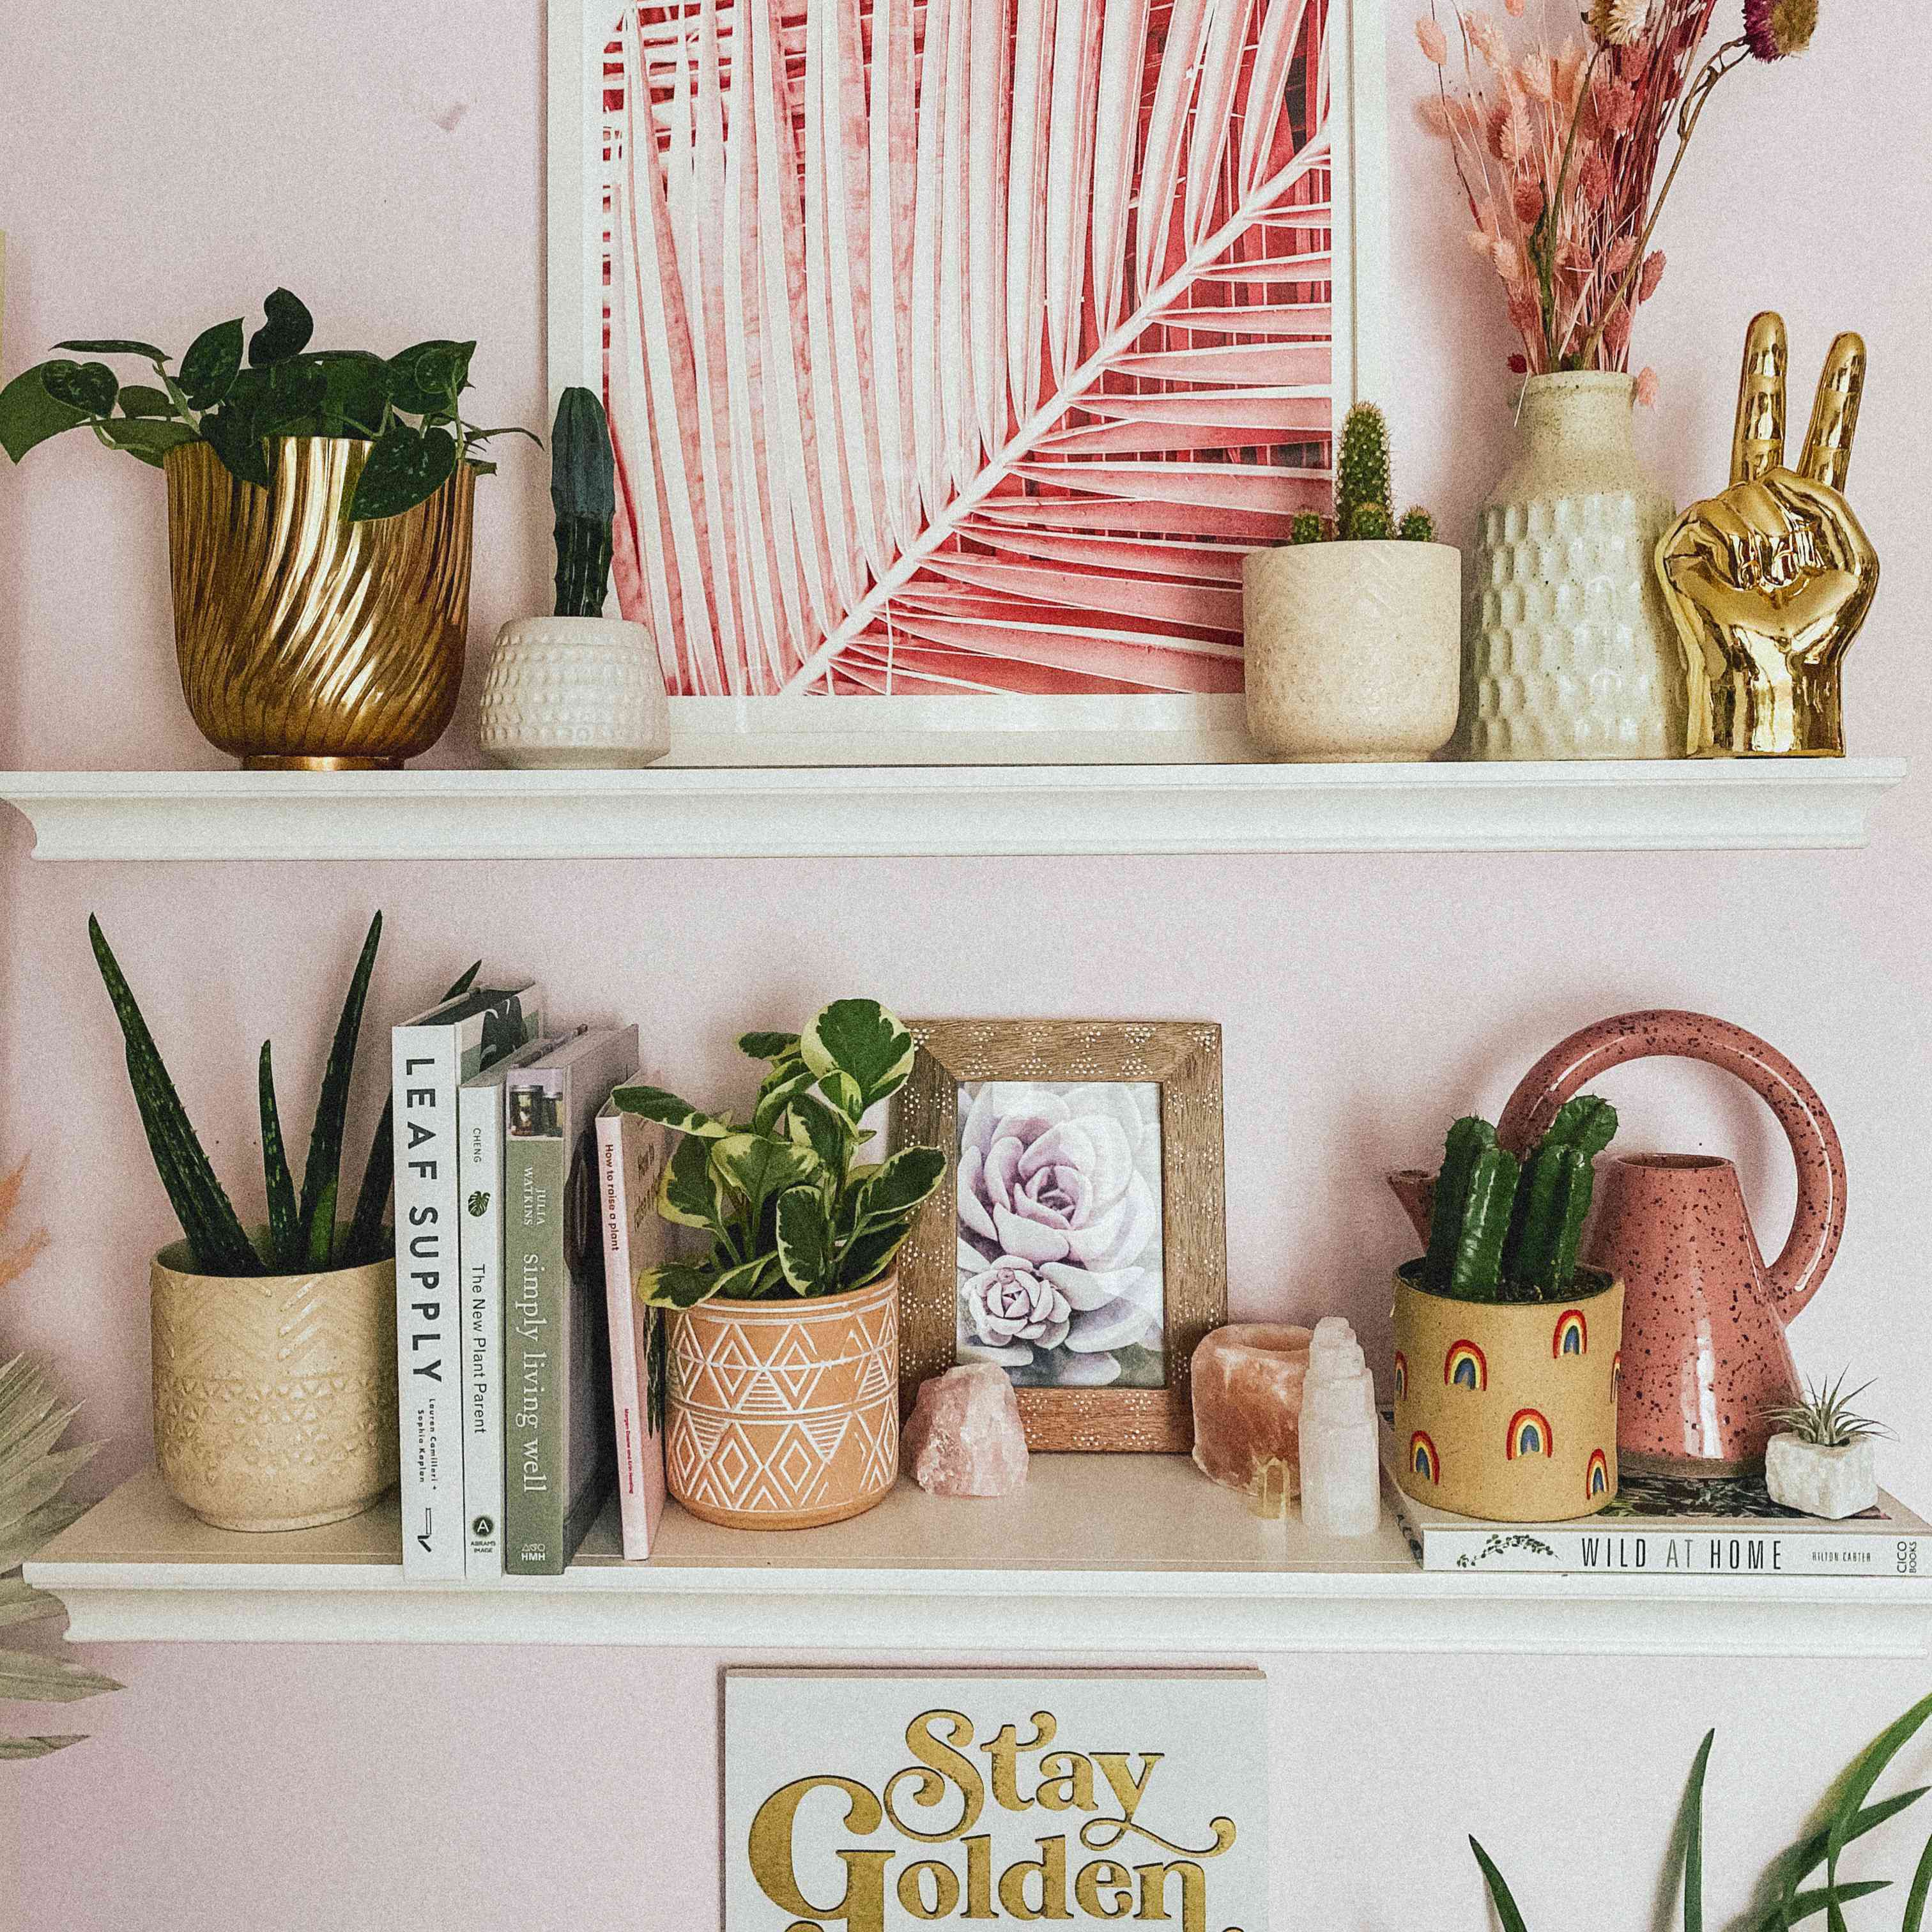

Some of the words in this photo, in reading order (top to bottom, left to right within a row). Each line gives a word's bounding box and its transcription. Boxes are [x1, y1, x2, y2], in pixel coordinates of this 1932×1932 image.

[406, 1058, 438, 1180] LEAF
[472, 1127, 482, 1163] CHENG
[604, 1144, 614, 1168] How
[606, 1170, 614, 1181] to
[523, 1167, 533, 1225] WATKINS
[535, 1188, 546, 1225] JULIA
[607, 1184, 617, 1211] raise
[608, 1223, 620, 1251] plant
[408, 1206, 442, 1383] SUPPLY
[471, 1263, 486, 1293] The
[472, 1298, 486, 1332] New
[515, 1254, 548, 1342] simply
[473, 1337, 486, 1378] Plant
[515, 1351, 548, 1429] living
[417, 1409, 425, 1444] Sophia
[473, 1383, 487, 1434] Parent
[417, 1448, 427, 1483] Kaplan
[430, 1436, 438, 1482] Camilleri
[523, 1438, 547, 1492] well
[521, 1552, 546, 1561] HMH
[1581, 1538, 1646, 1568] WILD
[1666, 1539, 1694, 1568] AT
[1710, 1539, 1781, 1570] HOME
[1812, 1551, 1839, 1562] HILTON
[1842, 1551, 1871, 1563] CARTER
[1896, 1540, 1908, 1574] CICO
[1908, 1541, 1917, 1574] BOOKS
[882, 1708, 1237, 1859] Stay
[747, 1774, 1245, 1932] Golden
